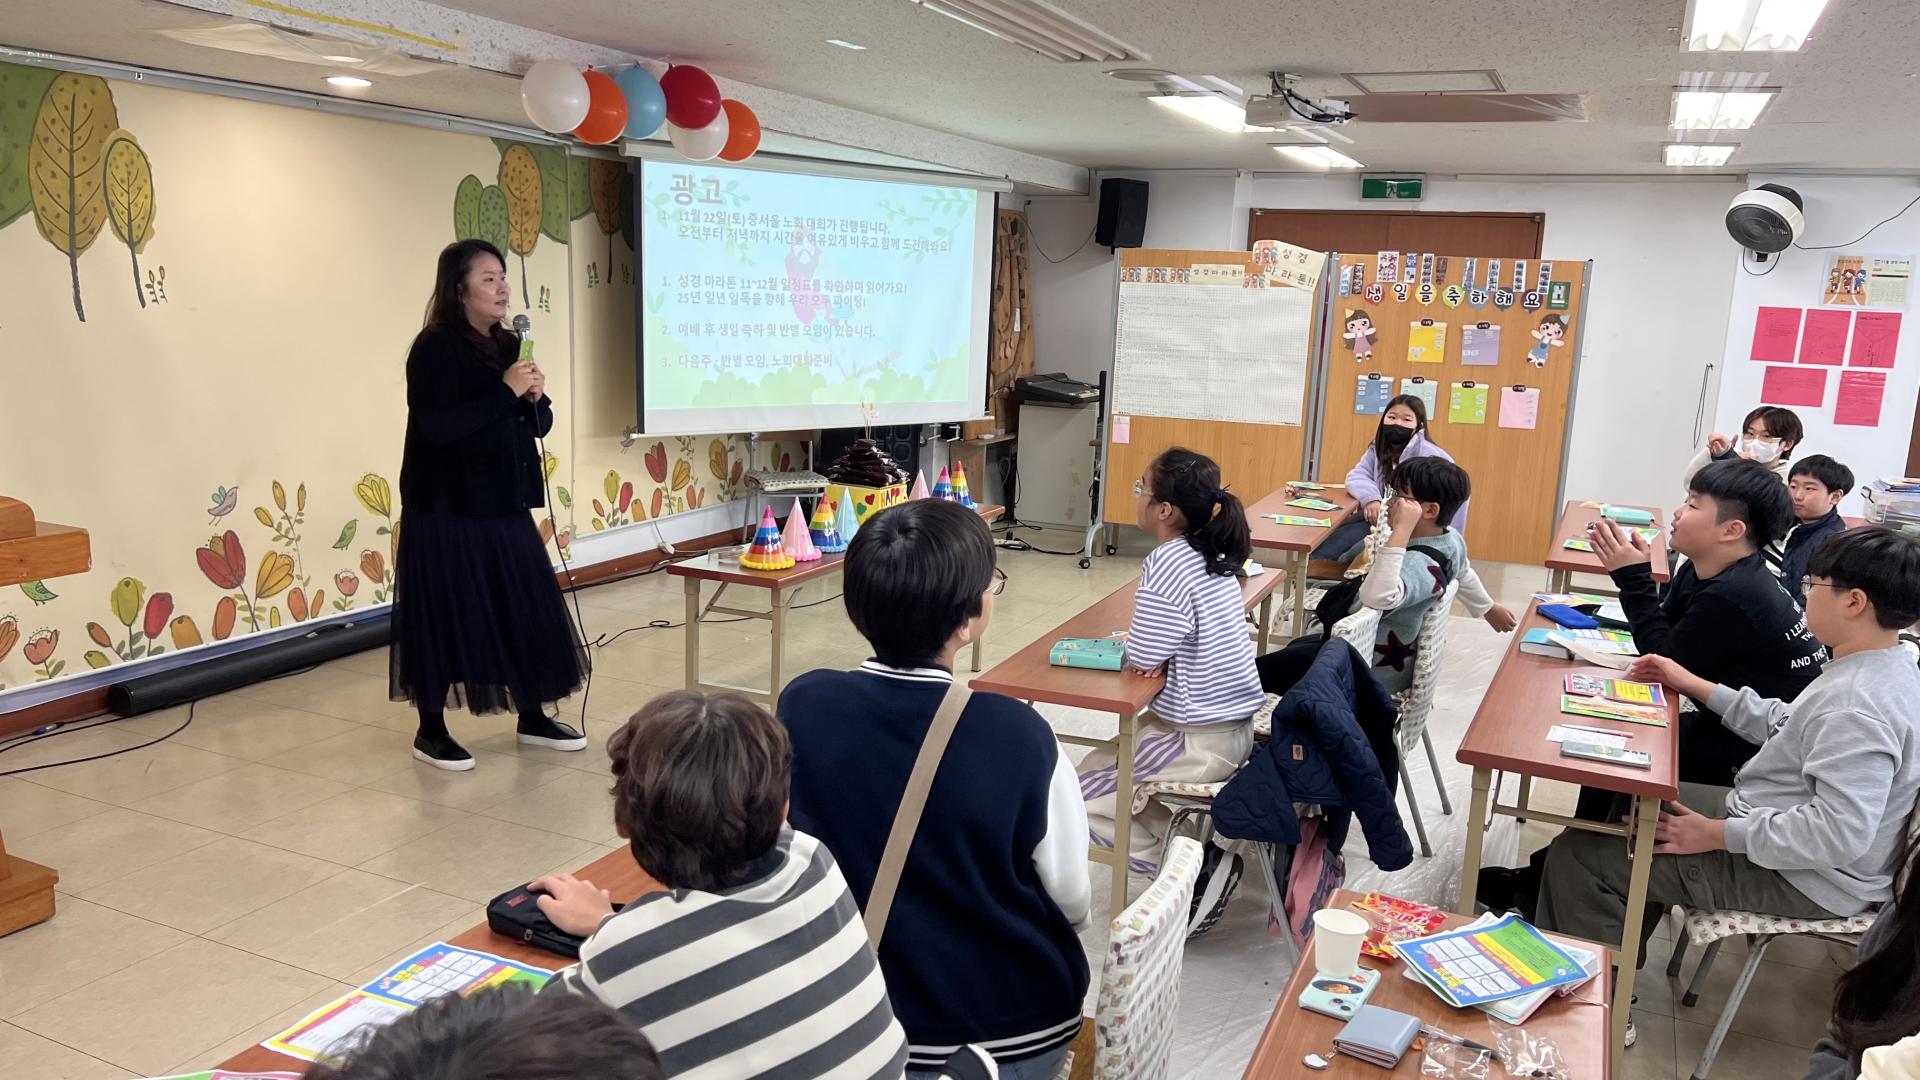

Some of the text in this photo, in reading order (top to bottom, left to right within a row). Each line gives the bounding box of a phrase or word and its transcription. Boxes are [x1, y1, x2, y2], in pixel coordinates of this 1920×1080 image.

[670, 174, 723, 206] 광고
[679, 208, 701, 223] 11월
[703, 210, 746, 226] 22일(토)
[783, 215, 804, 229] 노회
[806, 217, 837, 232] 대회가
[840, 219, 890, 235] 진행됩니다.
[678, 226, 723, 242] 오전부터
[727, 228, 770, 243] 저녁까지
[773, 231, 804, 245] 시간을
[807, 232, 847, 248] 여유있게
[849, 234, 880, 248] 비우고
[881, 236, 900, 250] 함께
[1283, 248, 1309, 264] 성경
[662, 275, 671, 286] 1.
[679, 273, 701, 289] 성경
[704, 274, 737, 289] 마라톤
[740, 276, 778, 290] 11~12월
[781, 277, 820, 292] 일정표를
[824, 279, 864, 293] 확인하며
[677, 291, 701, 304] 25년
[704, 291, 726, 305] 일년
[728, 292, 761, 306] 일독을
[764, 292, 785, 306] 향해
[788, 294, 808, 306] 우리
[811, 295, 831, 306] 모두
[678, 323, 700, 337] 예배
[703, 322, 715, 337] 후
[718, 323, 738, 337] 생일
[742, 323, 764, 337] 축하
[767, 323, 776, 337] 및
[779, 323, 800, 337] 반별
[802, 323, 832, 338] 모임이
[835, 324, 876, 338] 있습니다.
[678, 354, 712, 368] 다음주
[721, 354, 742, 368] 반별
[744, 354, 769, 369] 모임,
[1790, 656, 1811, 669] AND
